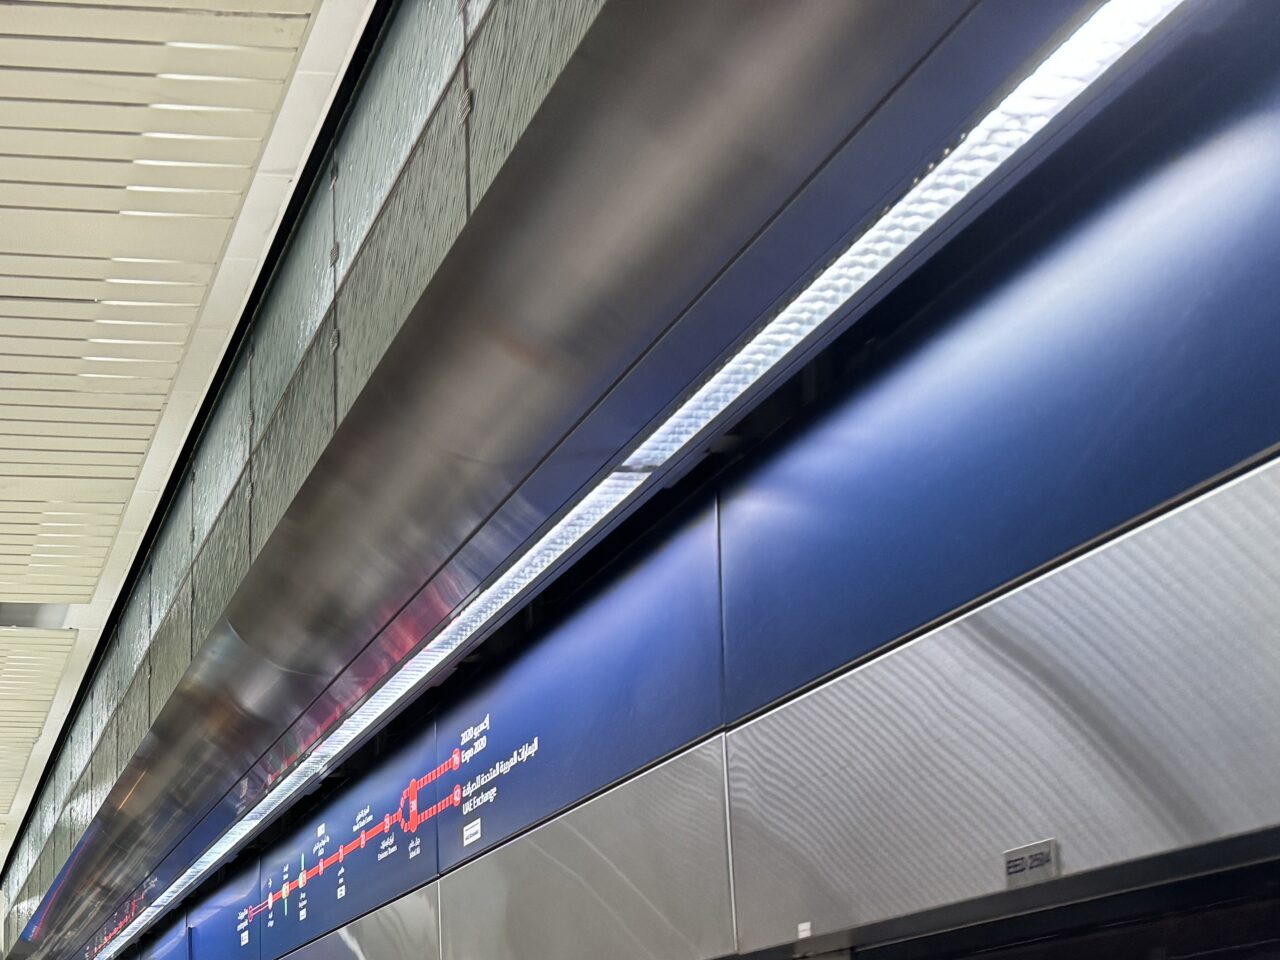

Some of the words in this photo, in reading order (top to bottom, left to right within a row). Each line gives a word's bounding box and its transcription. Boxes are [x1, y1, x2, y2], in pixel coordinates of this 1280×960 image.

[460, 726, 474, 746] 2020
[461, 748, 474, 764] Expo
[474, 735, 487, 755] 2020
[462, 797, 474, 815] UAE
[473, 786, 497, 809] Exchange
